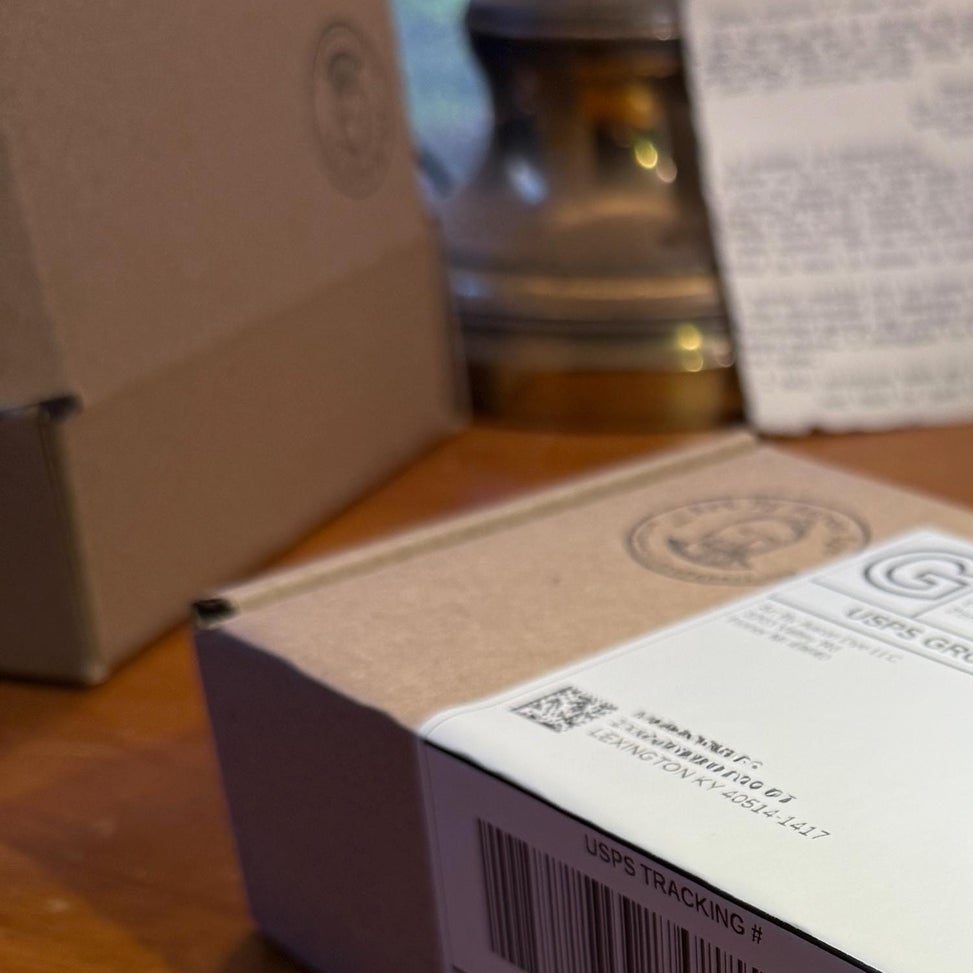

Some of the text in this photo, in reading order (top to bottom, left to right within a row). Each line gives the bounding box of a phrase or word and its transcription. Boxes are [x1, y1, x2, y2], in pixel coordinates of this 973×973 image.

[842, 607, 925, 640] USPS
[589, 728, 697, 779] LEXINGTON
[691, 775, 725, 792] KY
[720, 788, 831, 840] 40514-1417
[585, 833, 763, 944] USPS TRACKING #
